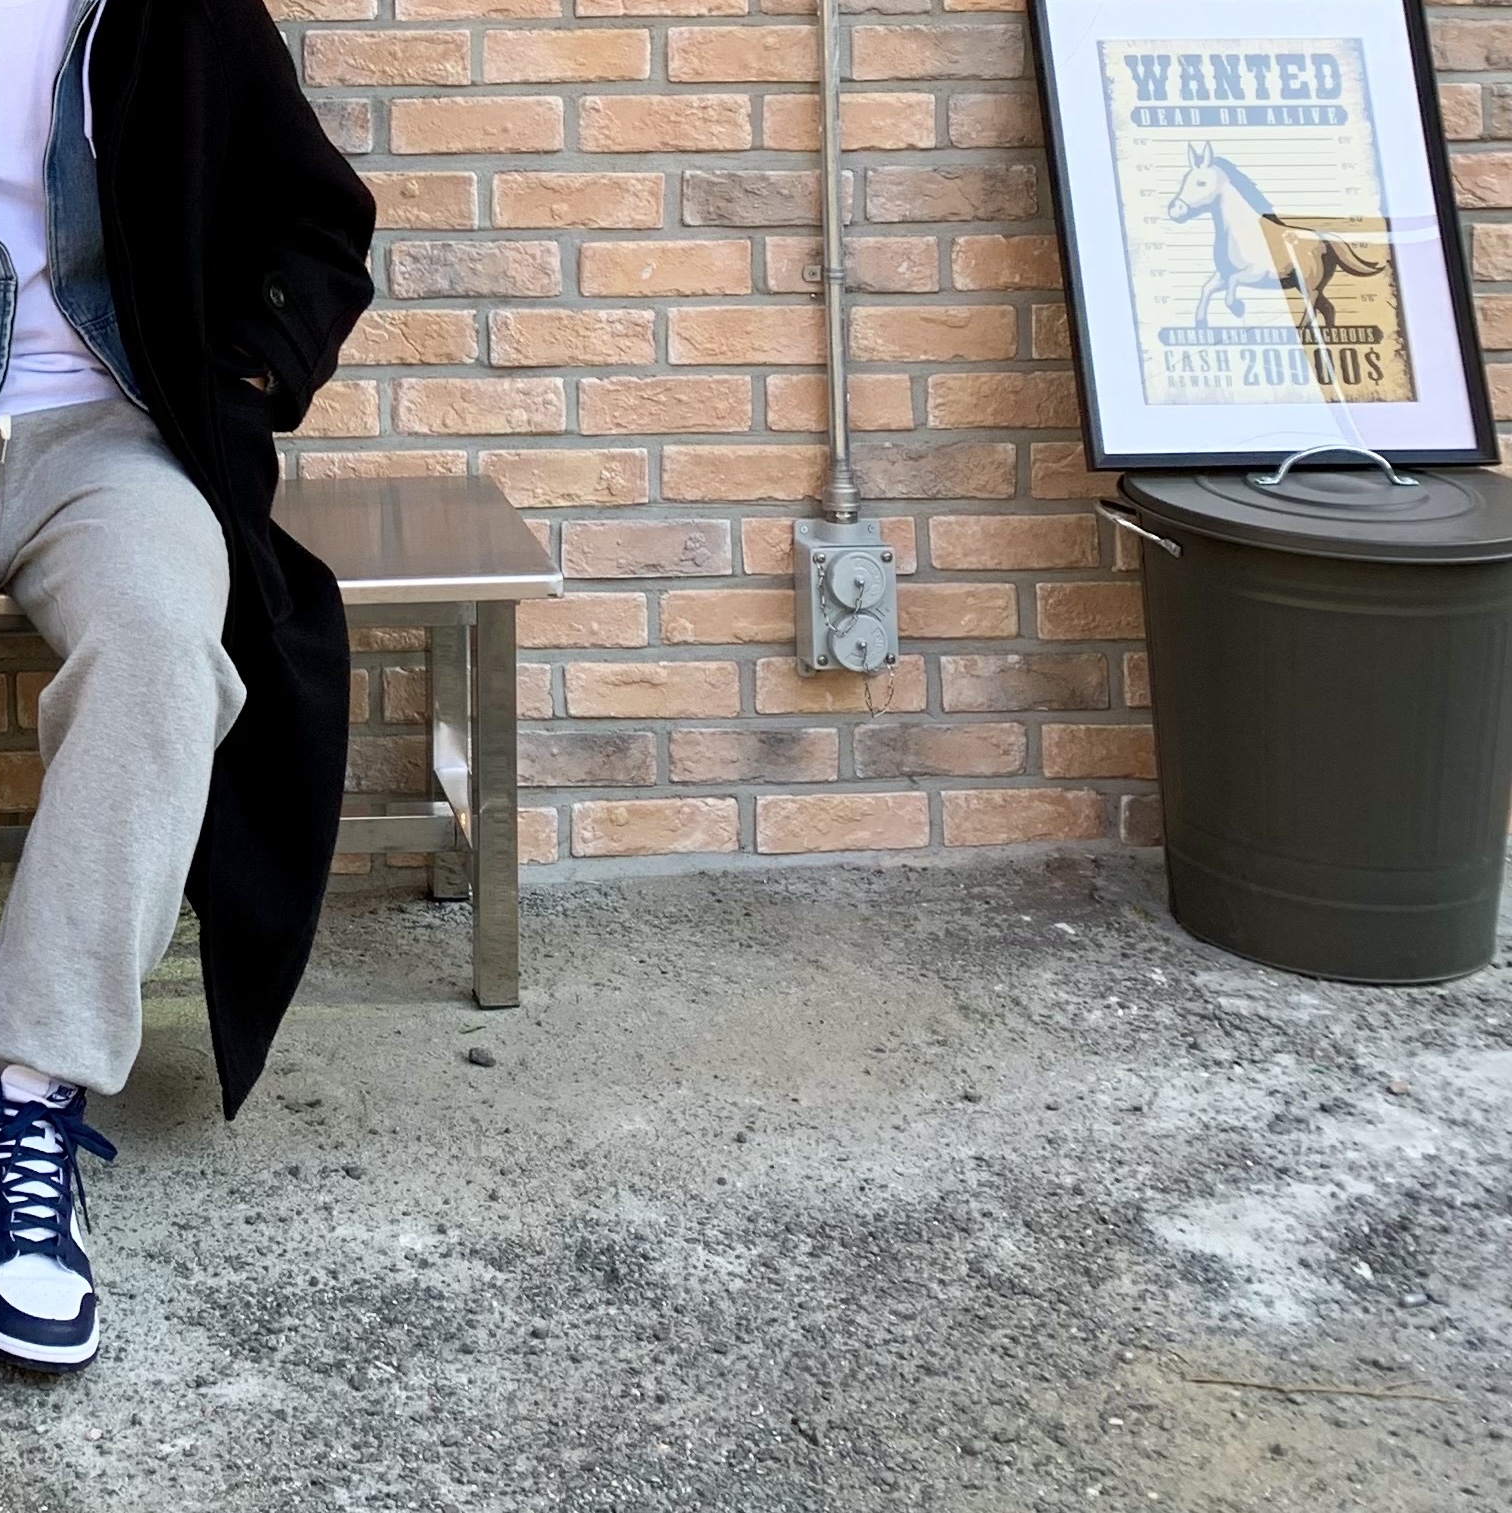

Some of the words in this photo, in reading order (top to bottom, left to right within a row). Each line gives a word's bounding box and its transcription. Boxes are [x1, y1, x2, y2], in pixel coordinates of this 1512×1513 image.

[1123, 53, 1342, 102] WANTED
[1140, 108, 1201, 126] DEAD
[1220, 108, 1248, 125] OR
[1267, 107, 1338, 125] ALIVE
[1297, 327, 1375, 343] AGEROUS
[1164, 349, 1232, 373] CASH
[1240, 347, 1385, 386] 20000$
